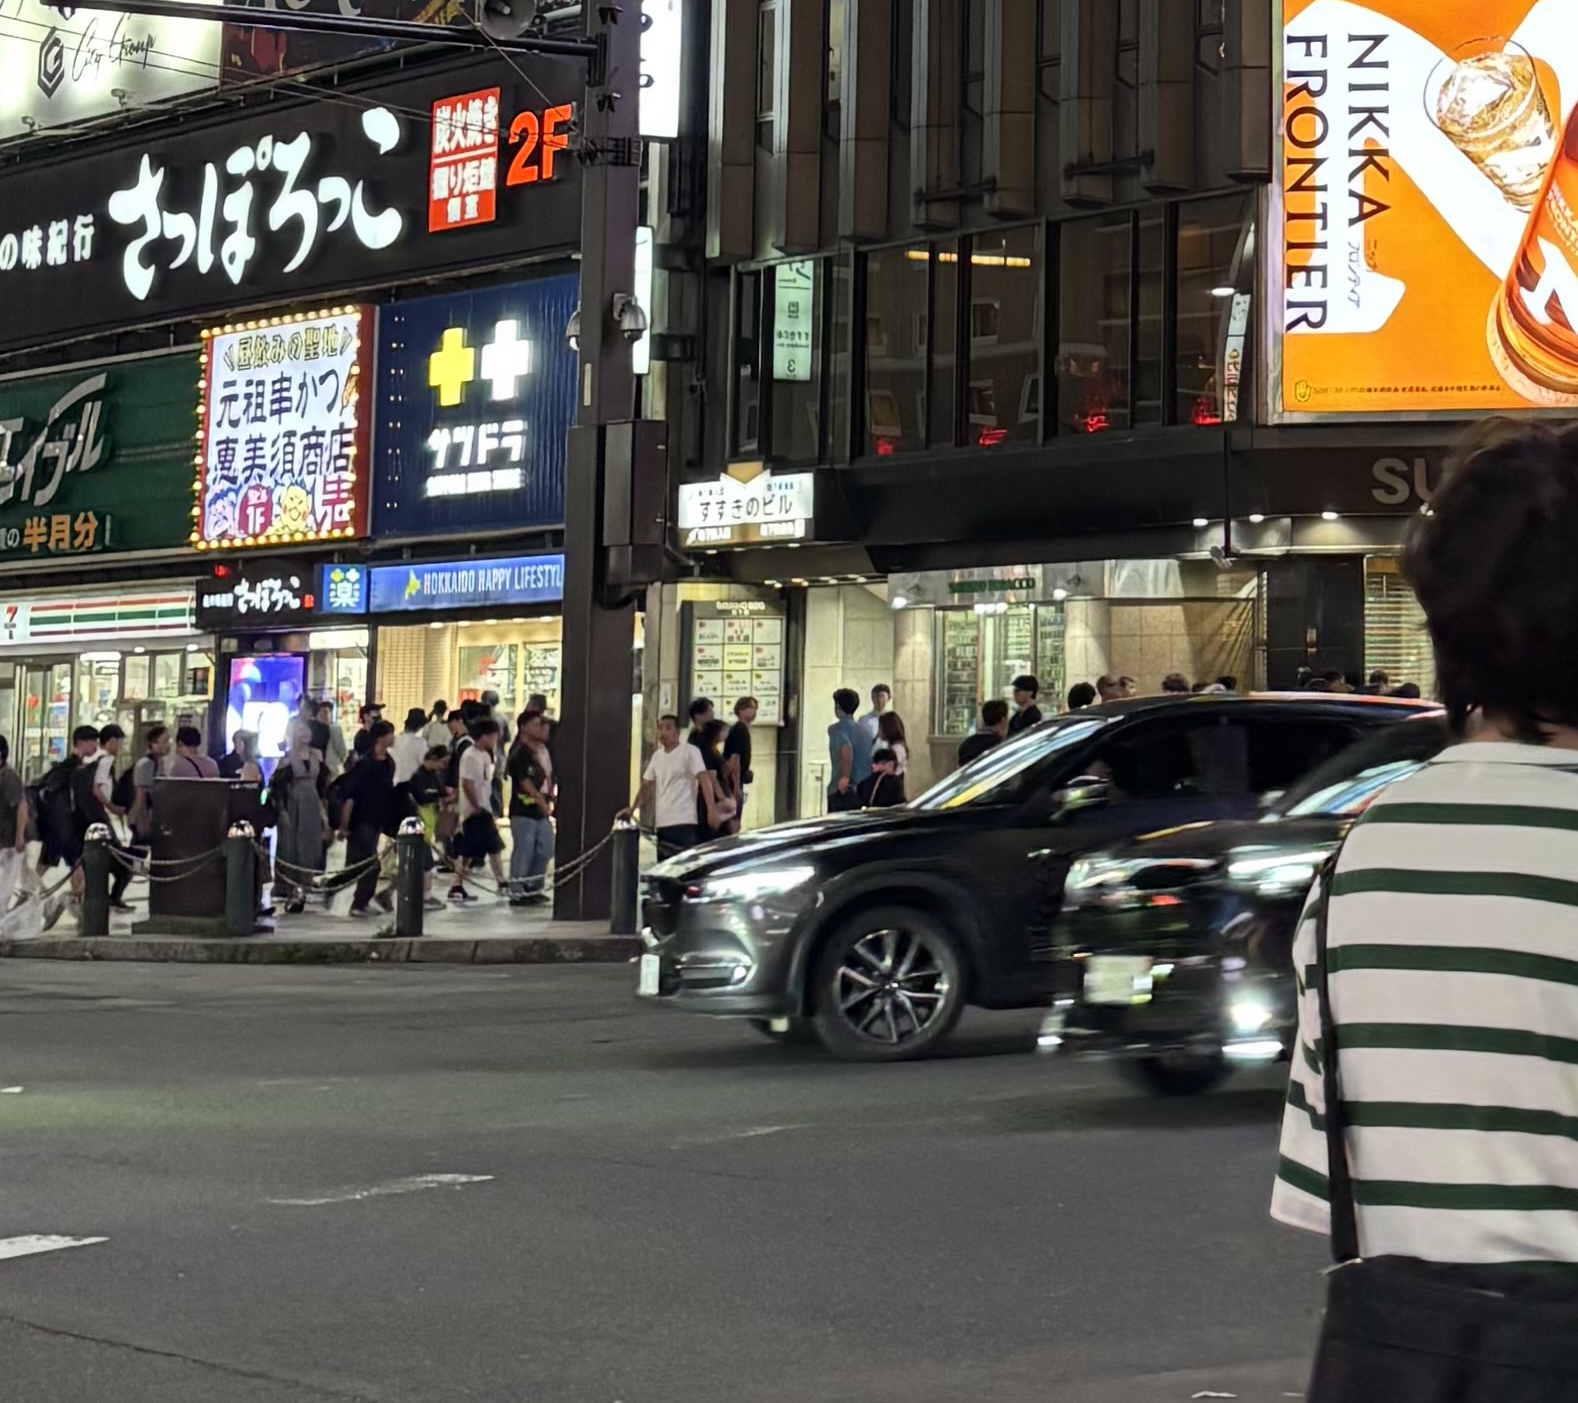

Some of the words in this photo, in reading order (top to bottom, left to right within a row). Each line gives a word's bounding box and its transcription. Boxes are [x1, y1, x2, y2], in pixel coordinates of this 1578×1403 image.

[506, 103, 573, 187] 2F
[1347, 32, 1392, 228] NIKKA
[1285, 33, 1330, 334] FRONTIER
[216, 368, 341, 429] 元祖串かつ
[213, 421, 353, 486] 恵美須商店
[700, 494, 793, 523] すすきのビル
[423, 568, 475, 595] HOKKAIDO
[478, 564, 512, 593] HAPPY
